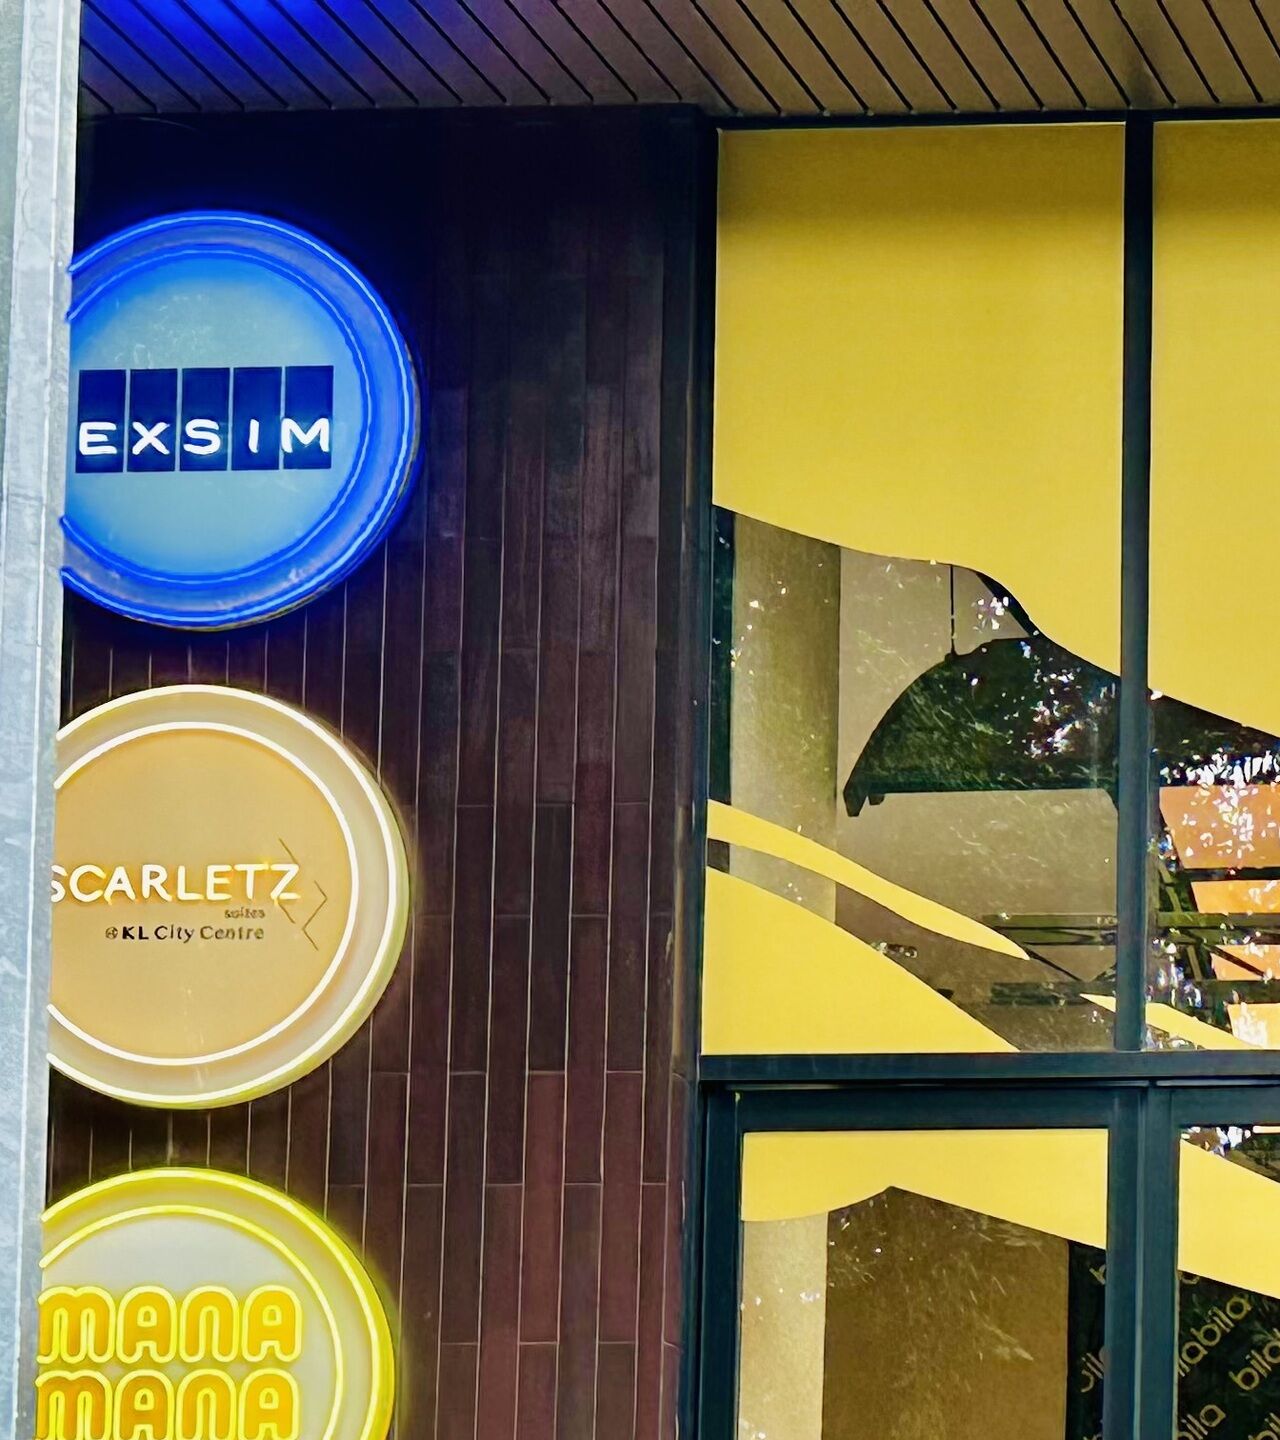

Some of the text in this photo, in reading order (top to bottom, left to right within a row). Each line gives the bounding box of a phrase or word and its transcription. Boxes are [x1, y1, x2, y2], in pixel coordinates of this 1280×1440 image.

[78, 418, 332, 456] EXSIM
[154, 924, 194, 944] City
[199, 925, 265, 941] Centre
